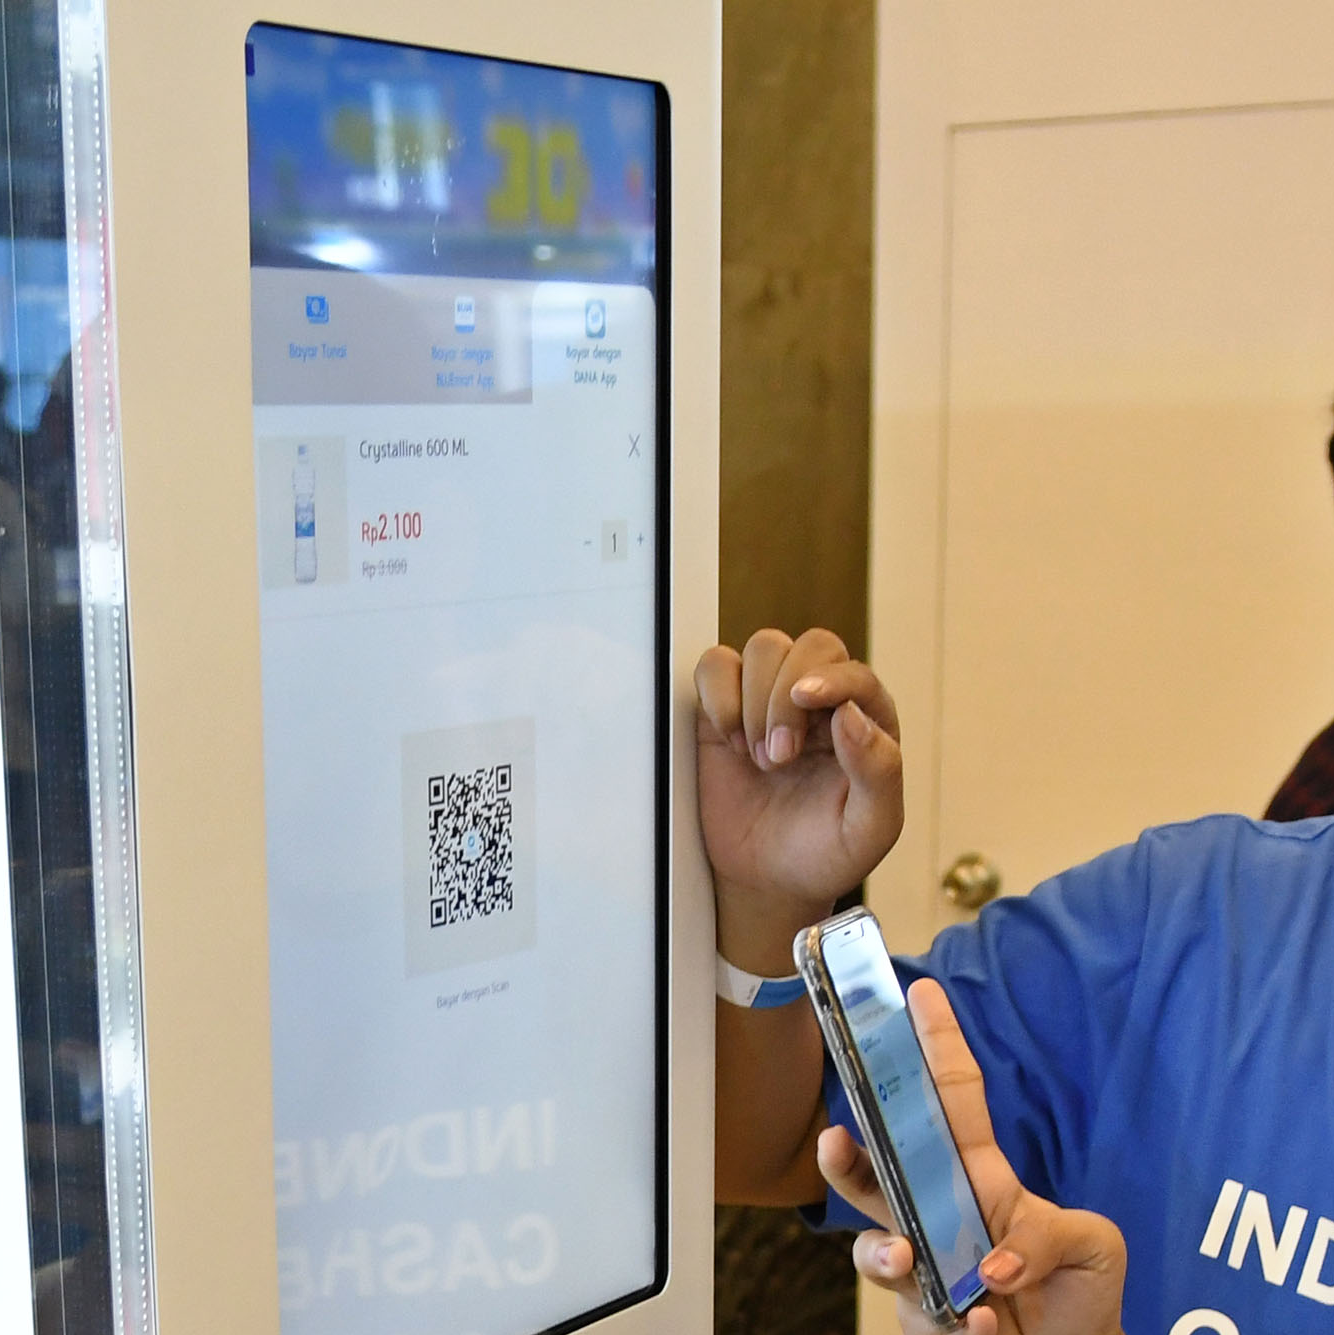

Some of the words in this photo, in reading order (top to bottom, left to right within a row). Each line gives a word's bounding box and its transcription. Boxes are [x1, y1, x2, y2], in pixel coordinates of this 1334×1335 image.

[359, 439, 422, 463] Crystalline
[426, 438, 449, 457] 600
[451, 439, 469, 456] ML
[361, 512, 422, 546] Rp2.100
